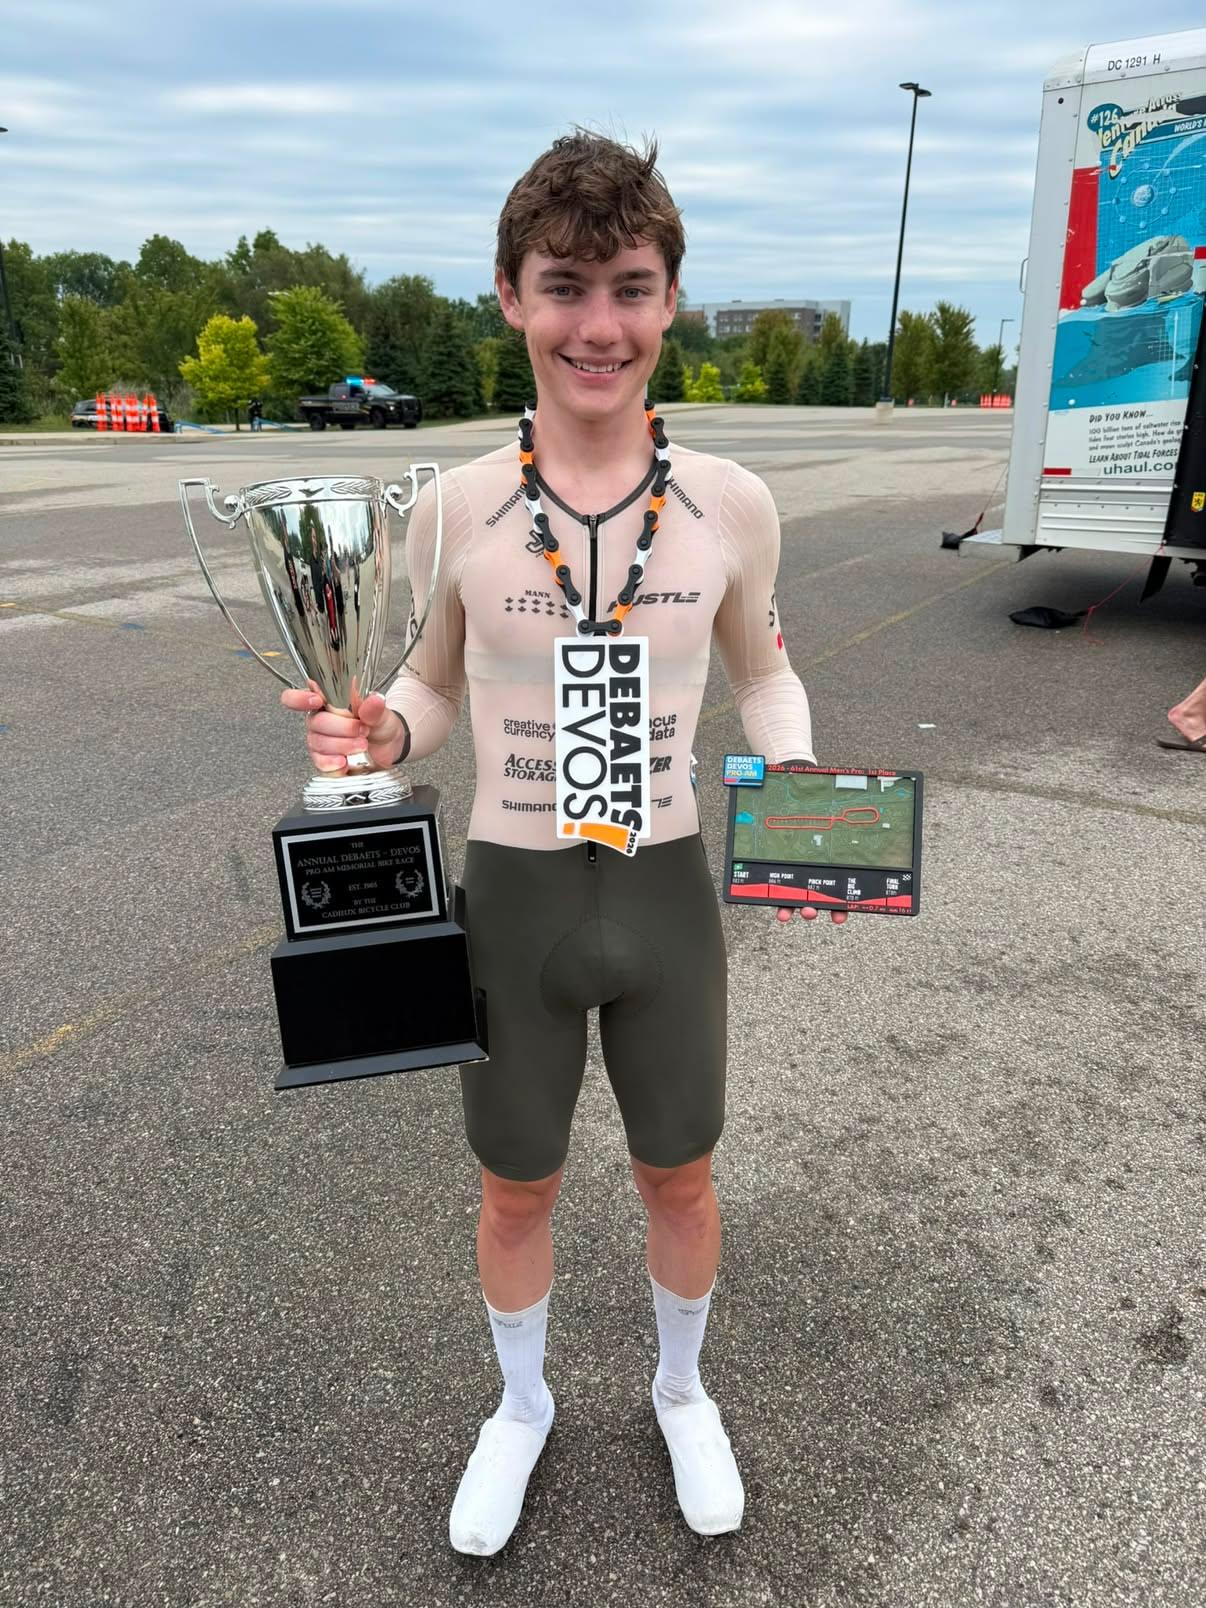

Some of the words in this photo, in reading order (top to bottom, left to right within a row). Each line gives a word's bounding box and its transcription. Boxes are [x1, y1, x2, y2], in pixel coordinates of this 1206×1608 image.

[1107, 60, 1122, 71] DC
[1125, 56, 1147, 69] 1291
[1153, 53, 1161, 65] H
[1090, 108, 1119, 127] #126
[1089, 414, 1103, 423] DID
[1105, 412, 1121, 421] YOU
[1103, 426, 1119, 434] billion
[1135, 422, 1142, 430] of
[1143, 421, 1169, 429] saltwater
[1134, 439, 1161, 447] Canada's
[1089, 454, 1109, 463] LEARN
[1110, 452, 1132, 461] ABOUT
[1134, 450, 1151, 459] TIDAL
[1152, 448, 1178, 458] FORCES
[669, 476, 705, 519] HIMANO
[525, 589, 551, 598] MANN
[503, 718, 551, 731] creative
[649, 714, 677, 728] cus
[504, 726, 556, 742] currency
[561, 644, 608, 820] DEVOS
[609, 643, 643, 832] DEBAETS
[727, 756, 762, 764] DEBAETS
[504, 767, 556, 782] STORAG
[297, 855, 337, 868] ANNUAL
[340, 850, 381, 862] DEBAETS
[390, 846, 421, 857] DEVOS
[336, 862, 376, 872] MEMORIAL
[377, 859, 394, 867] BIKE
[395, 857, 415, 865] RACE
[322, 908, 357, 919] CADIEUX
[358, 903, 389, 914] BICYCLE
[390, 902, 411, 910] CLUB
